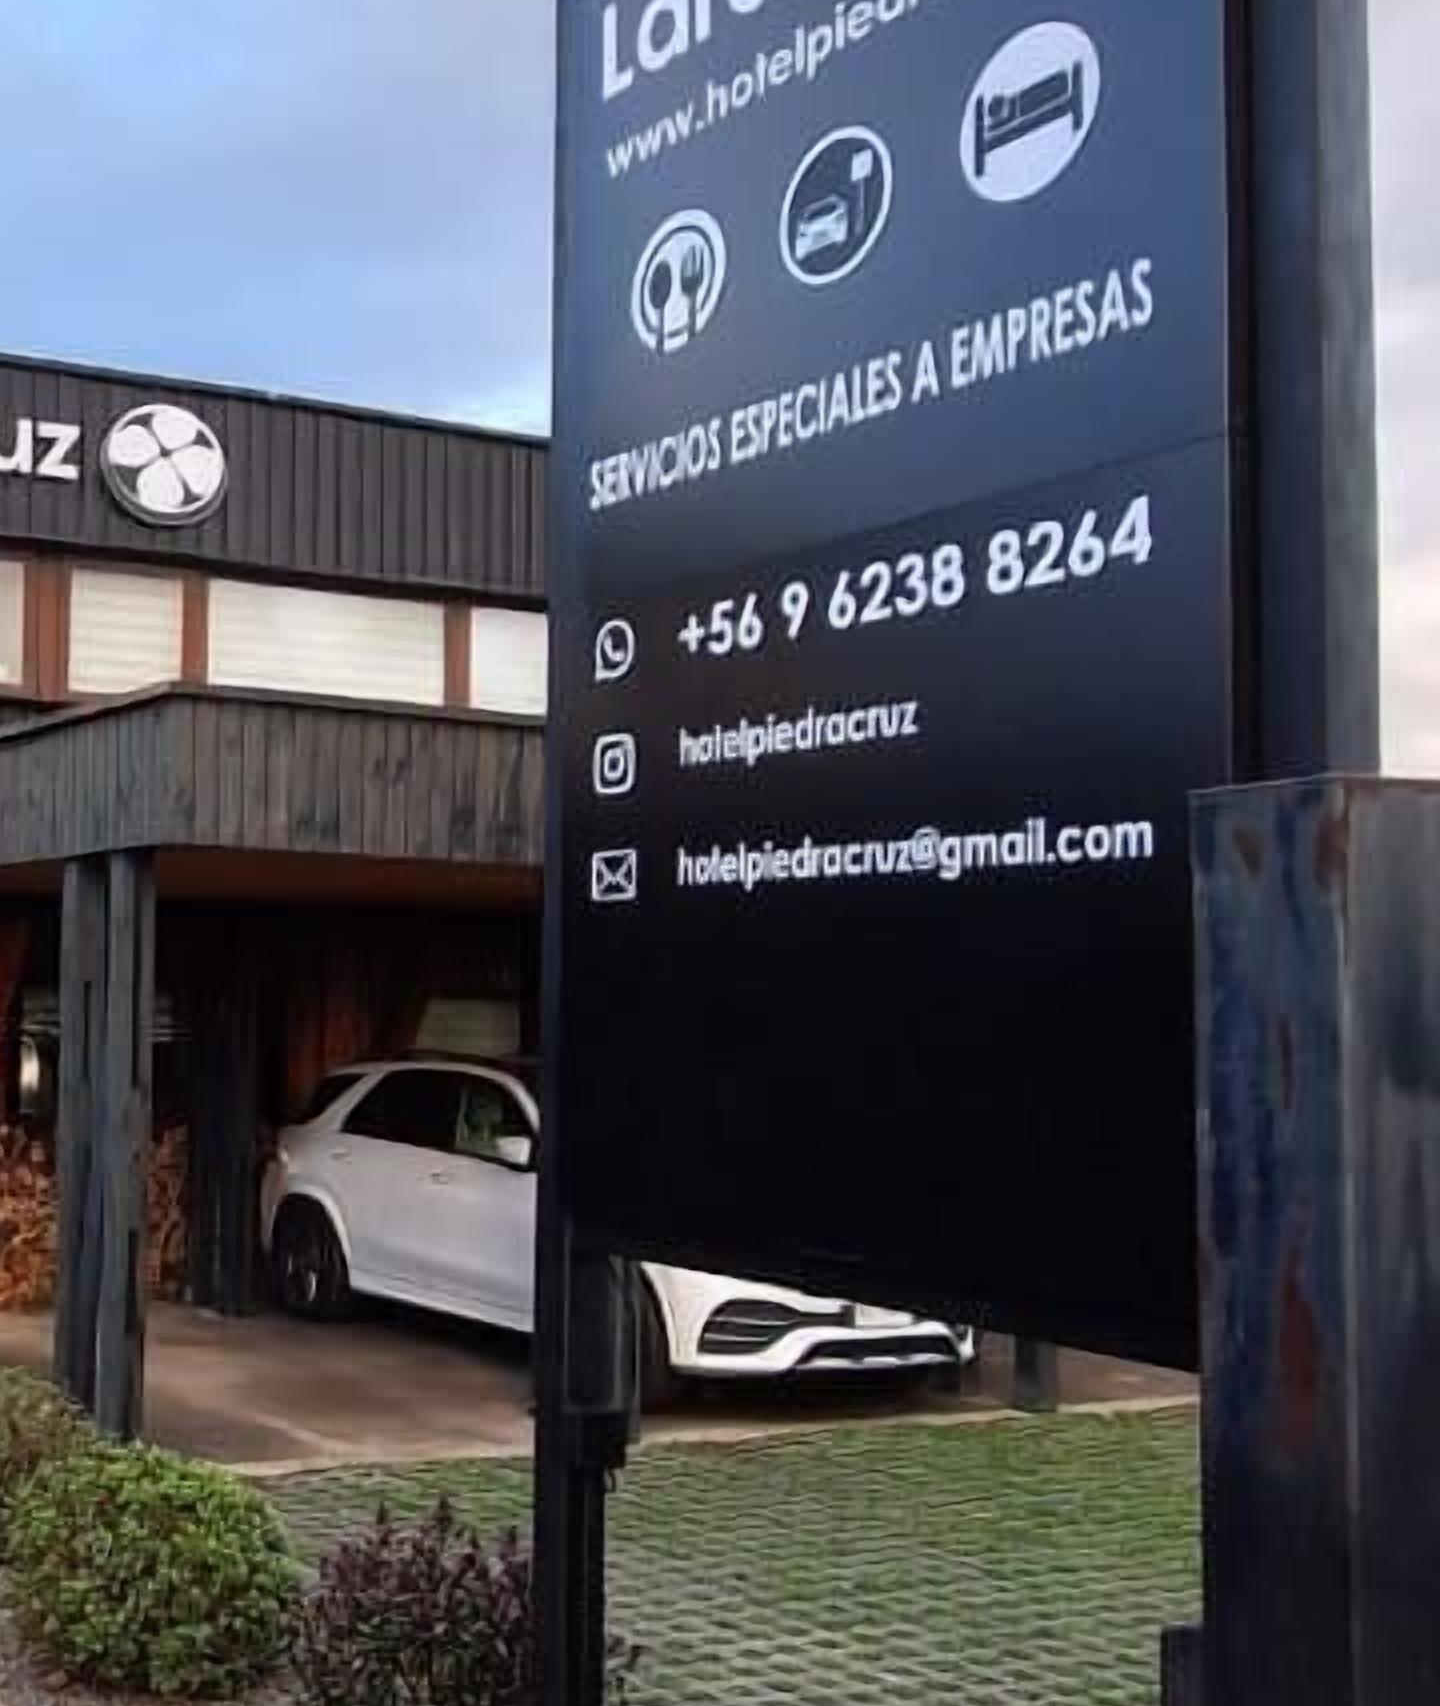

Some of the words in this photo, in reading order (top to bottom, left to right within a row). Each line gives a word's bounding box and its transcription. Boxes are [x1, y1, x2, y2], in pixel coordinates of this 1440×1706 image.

[589, 416, 722, 510] SERVICIOS
[731, 353, 903, 465] ESPECIALES
[911, 346, 941, 399] A
[950, 258, 1154, 390] EMPRESAS
[677, 593, 764, 656] +56
[780, 581, 810, 640] 9
[826, 542, 964, 630] 6238
[986, 493, 1153, 595] 8264
[678, 700, 919, 767] hotelpiedracruz
[677, 816, 1154, 893] hotelpiedracruz@gmail.com
